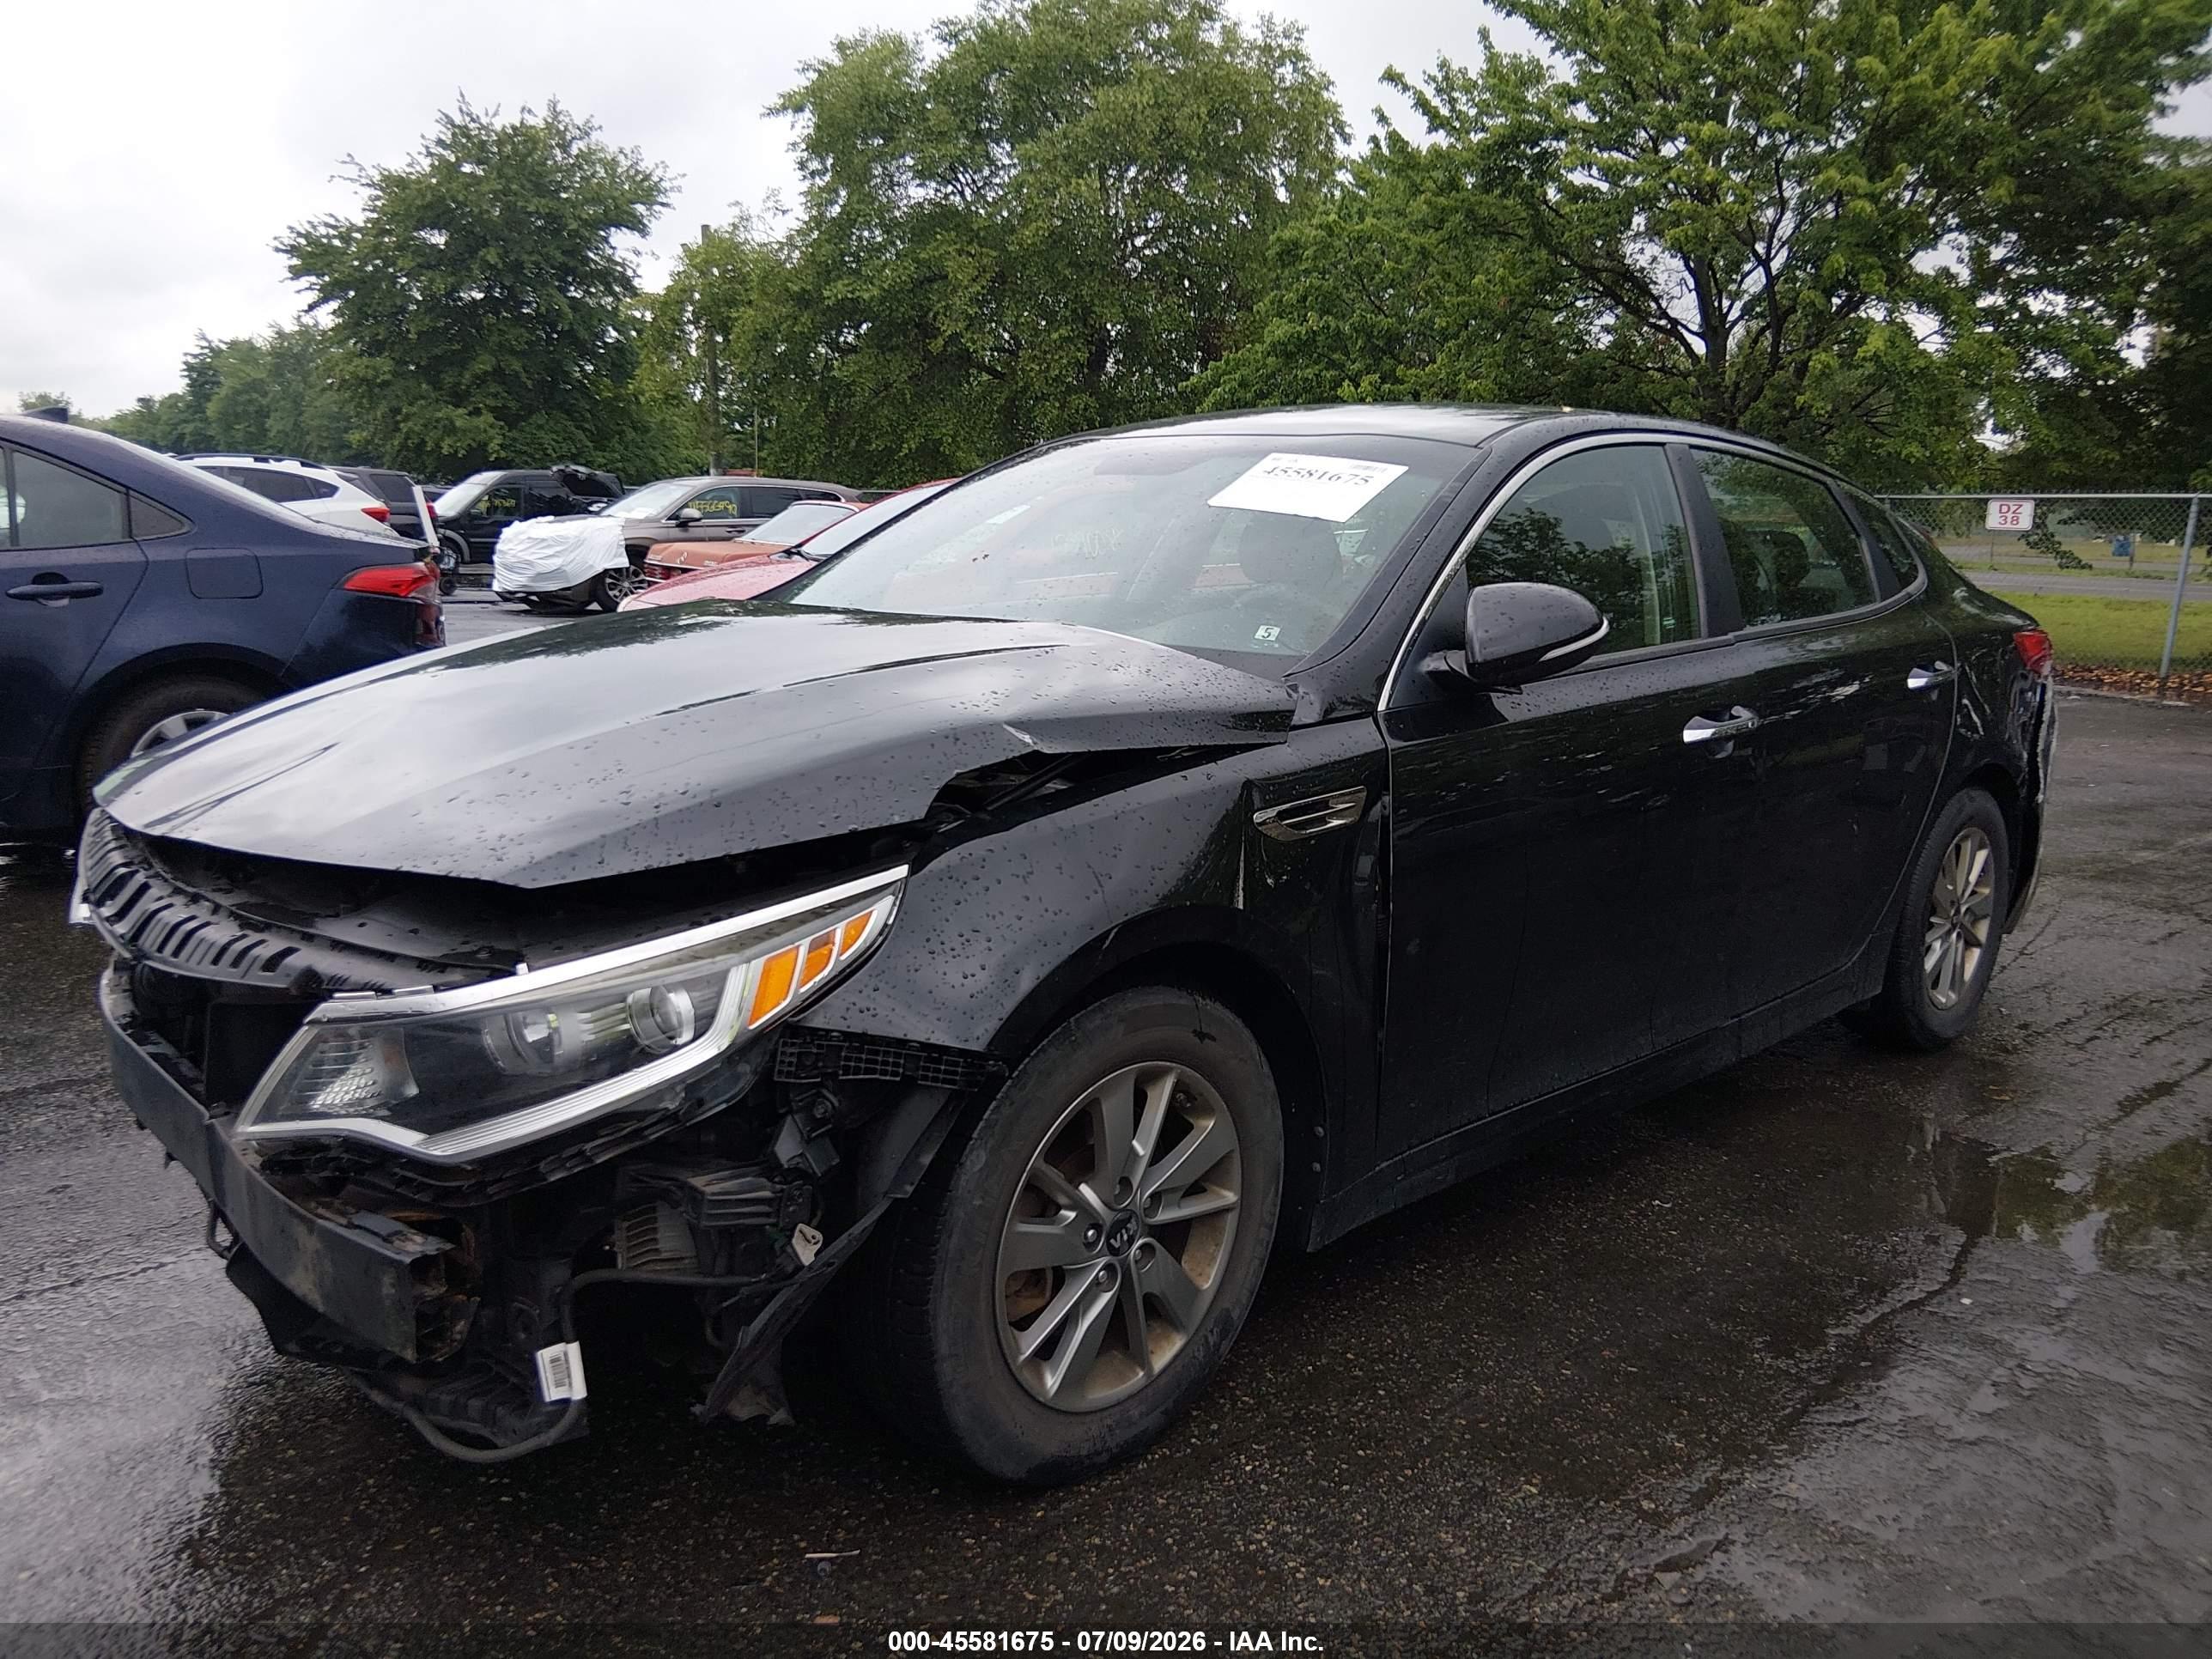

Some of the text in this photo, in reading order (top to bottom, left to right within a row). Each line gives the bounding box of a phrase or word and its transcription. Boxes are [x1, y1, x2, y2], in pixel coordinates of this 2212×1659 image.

[1263, 465, 1374, 486] 45581675
[1998, 503, 2024, 515] DZ
[1998, 514, 2021, 526] 38
[1261, 627, 1275, 640] 5
